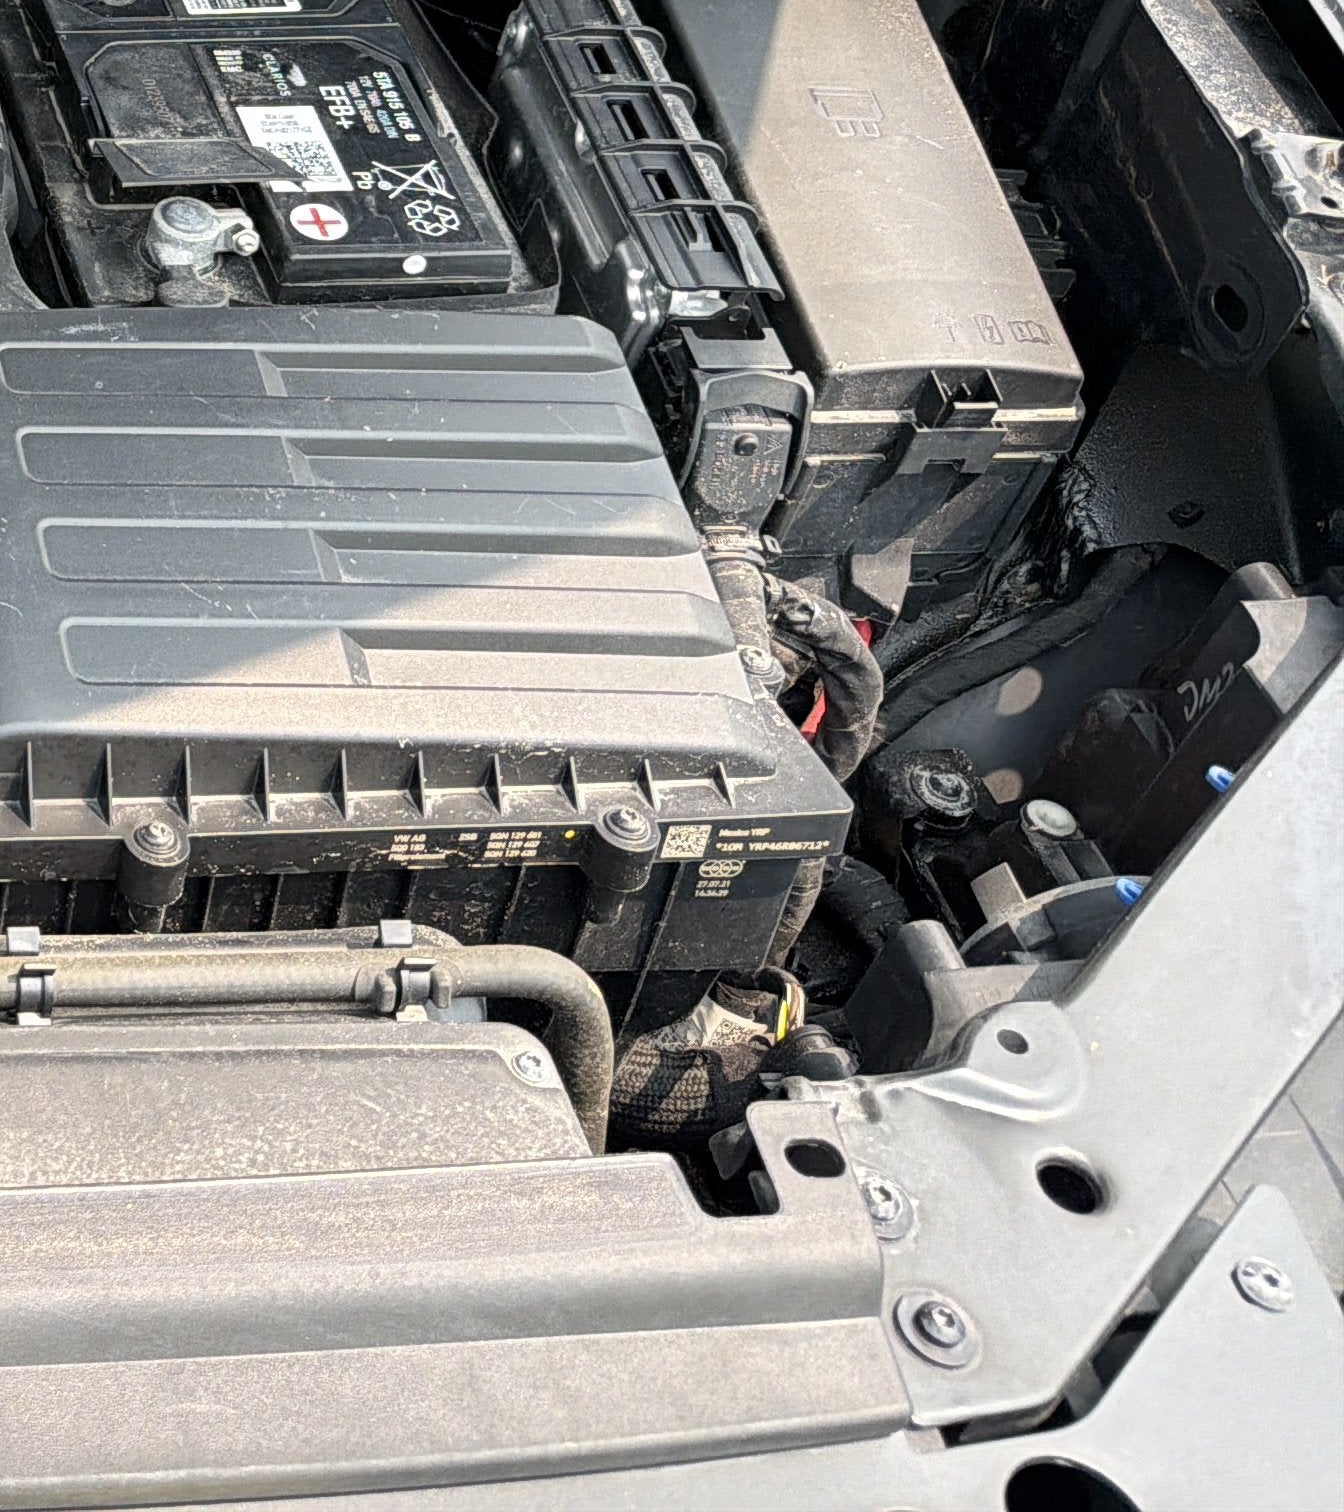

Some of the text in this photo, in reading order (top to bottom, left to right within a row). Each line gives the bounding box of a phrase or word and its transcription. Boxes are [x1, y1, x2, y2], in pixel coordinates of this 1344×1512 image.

[262, 53, 292, 97] CLARIOS
[319, 85, 357, 130] EFB+
[383, 90, 406, 109] 915
[351, 171, 376, 190] Pb
